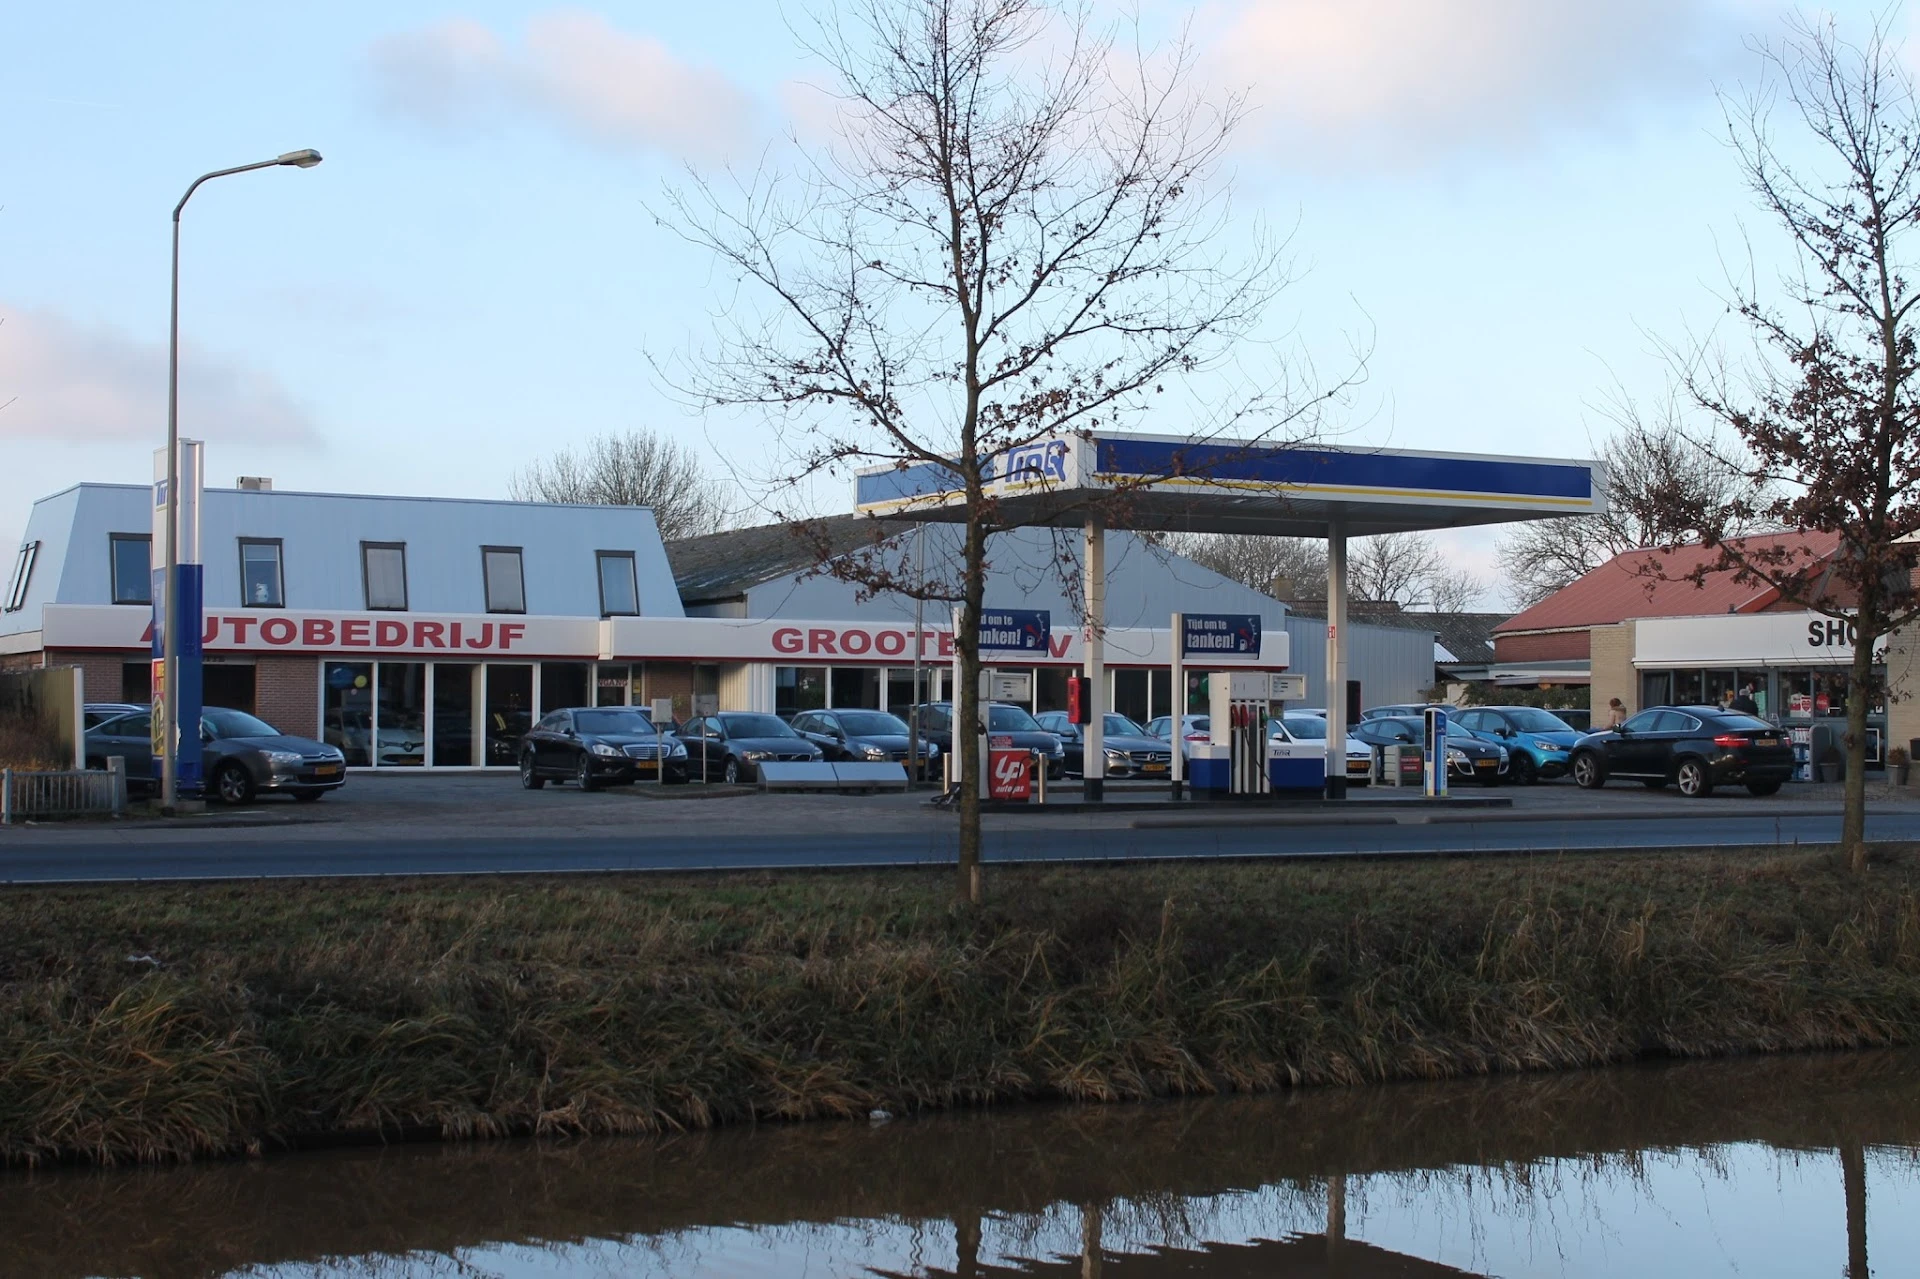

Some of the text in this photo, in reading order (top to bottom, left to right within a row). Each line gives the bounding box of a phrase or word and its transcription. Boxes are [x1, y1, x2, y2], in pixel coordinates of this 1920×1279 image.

[988, 615, 1003, 625] om
[1003, 615, 1013, 625] te
[1187, 619, 1227, 630] Tijd om te
[1187, 632, 1235, 648] tanken!
